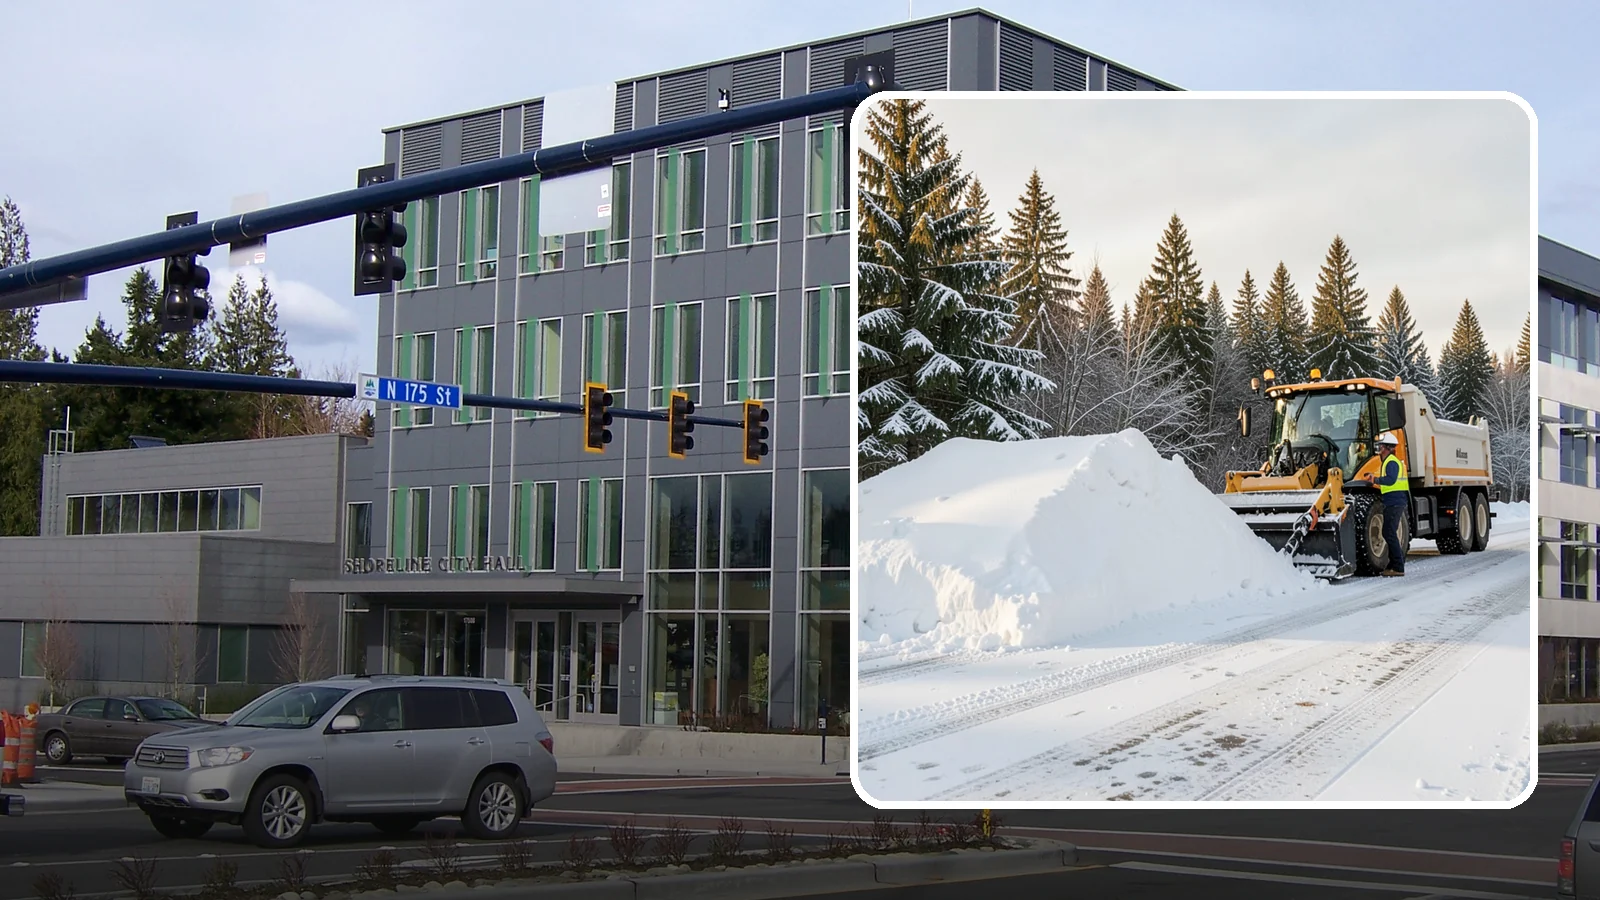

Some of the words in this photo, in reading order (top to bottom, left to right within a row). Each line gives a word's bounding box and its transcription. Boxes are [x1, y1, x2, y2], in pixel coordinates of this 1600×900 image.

[387, 380, 396, 400] N
[405, 382, 427, 403] 175
[436, 386, 451, 406] St
[344, 556, 432, 574] SHORELINE
[438, 555, 476, 573] CITY
[484, 555, 525, 573] HALL
